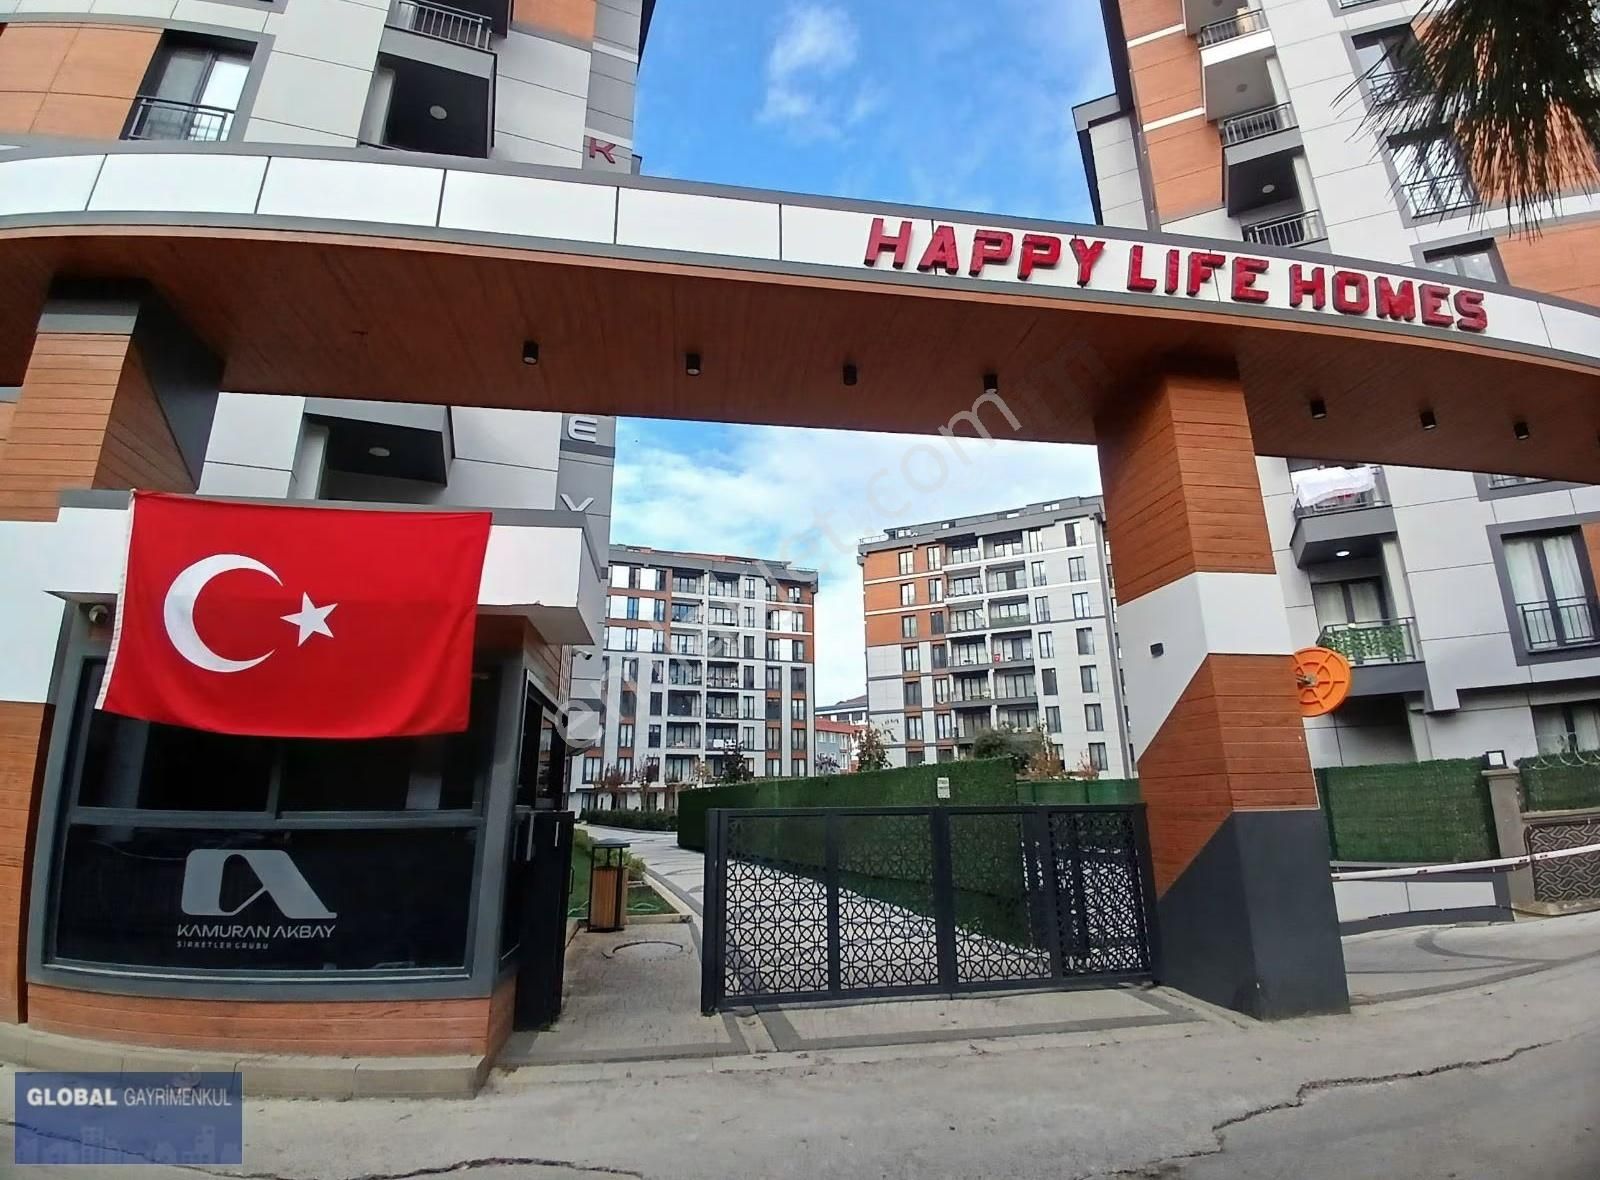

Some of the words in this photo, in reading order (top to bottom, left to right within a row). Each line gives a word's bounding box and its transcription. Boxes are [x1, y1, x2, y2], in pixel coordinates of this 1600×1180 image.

[863, 217, 1106, 287] HAPPY
[1126, 245, 1270, 304] LIFE
[1288, 263, 1488, 332] HOMES
[176, 924, 271, 938] KAMURAN
[273, 924, 337, 939] AKBAY
